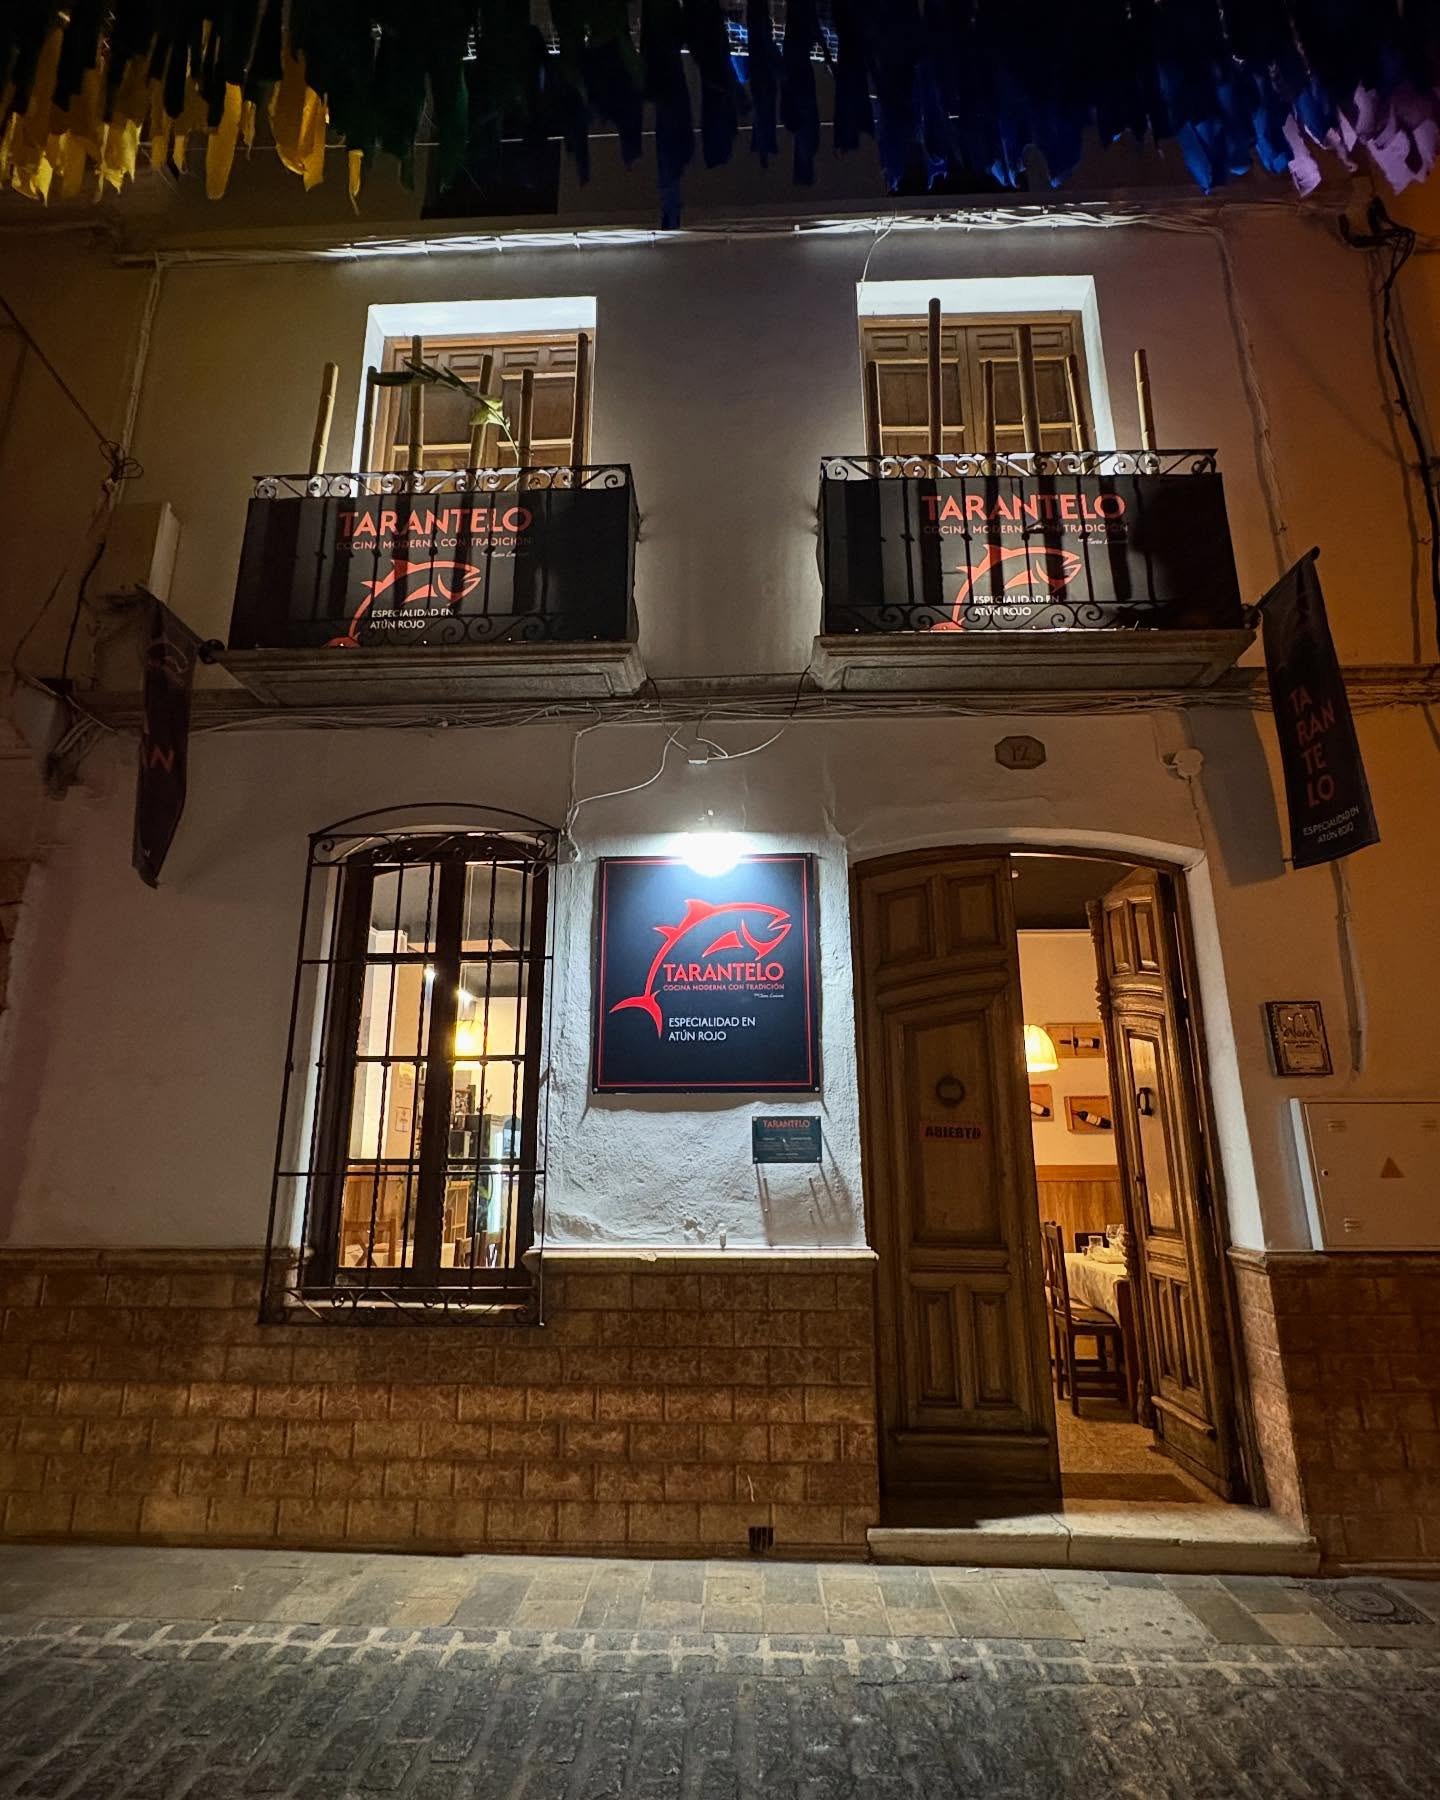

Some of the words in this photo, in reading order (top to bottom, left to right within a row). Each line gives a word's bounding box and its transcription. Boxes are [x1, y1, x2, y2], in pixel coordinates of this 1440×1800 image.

[922, 494, 1125, 520] TARANTELO
[340, 507, 532, 536] TARANTELO
[1002, 606, 1032, 616] ROJO
[397, 619, 426, 629] ROJO
[1306, 775, 1335, 807] LO
[663, 962, 785, 982] TARANTELO
[663, 984, 691, 992] COCINA
[745, 982, 785, 991] TRADICIÓN
[669, 1017, 740, 1028] ESPECIALIDAD
[741, 1017, 756, 1027] EN
[668, 1030, 696, 1042] ATÚN
[698, 1031, 727, 1041] ROJO
